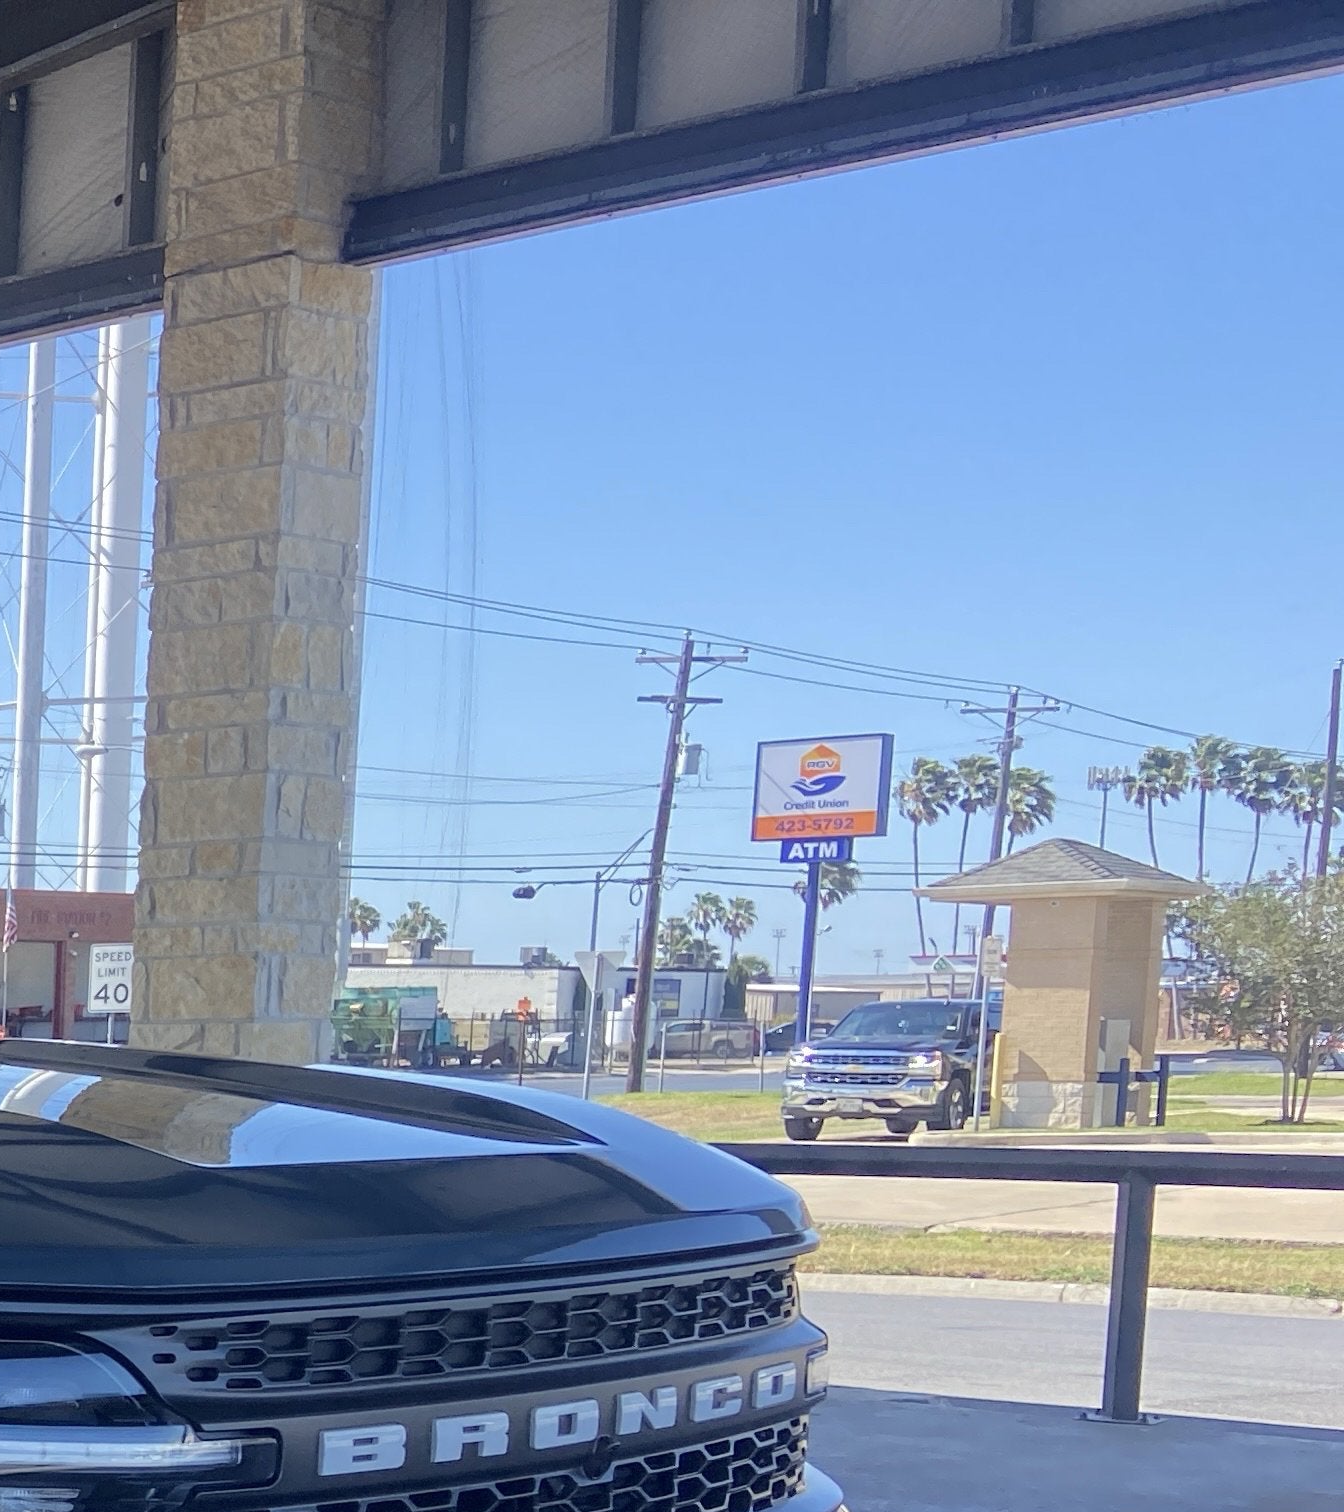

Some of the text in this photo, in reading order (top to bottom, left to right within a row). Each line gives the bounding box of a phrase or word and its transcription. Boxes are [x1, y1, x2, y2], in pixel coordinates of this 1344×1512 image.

[807, 760, 835, 769] RGV
[784, 798, 849, 811] Credit Union
[775, 817, 855, 832] 423-5792
[787, 841, 838, 860] ATM
[95, 951, 132, 962] SPEED
[97, 967, 127, 978] LIMIT
[93, 983, 129, 1004] 40
[317, 1361, 797, 1476] BRONCO
